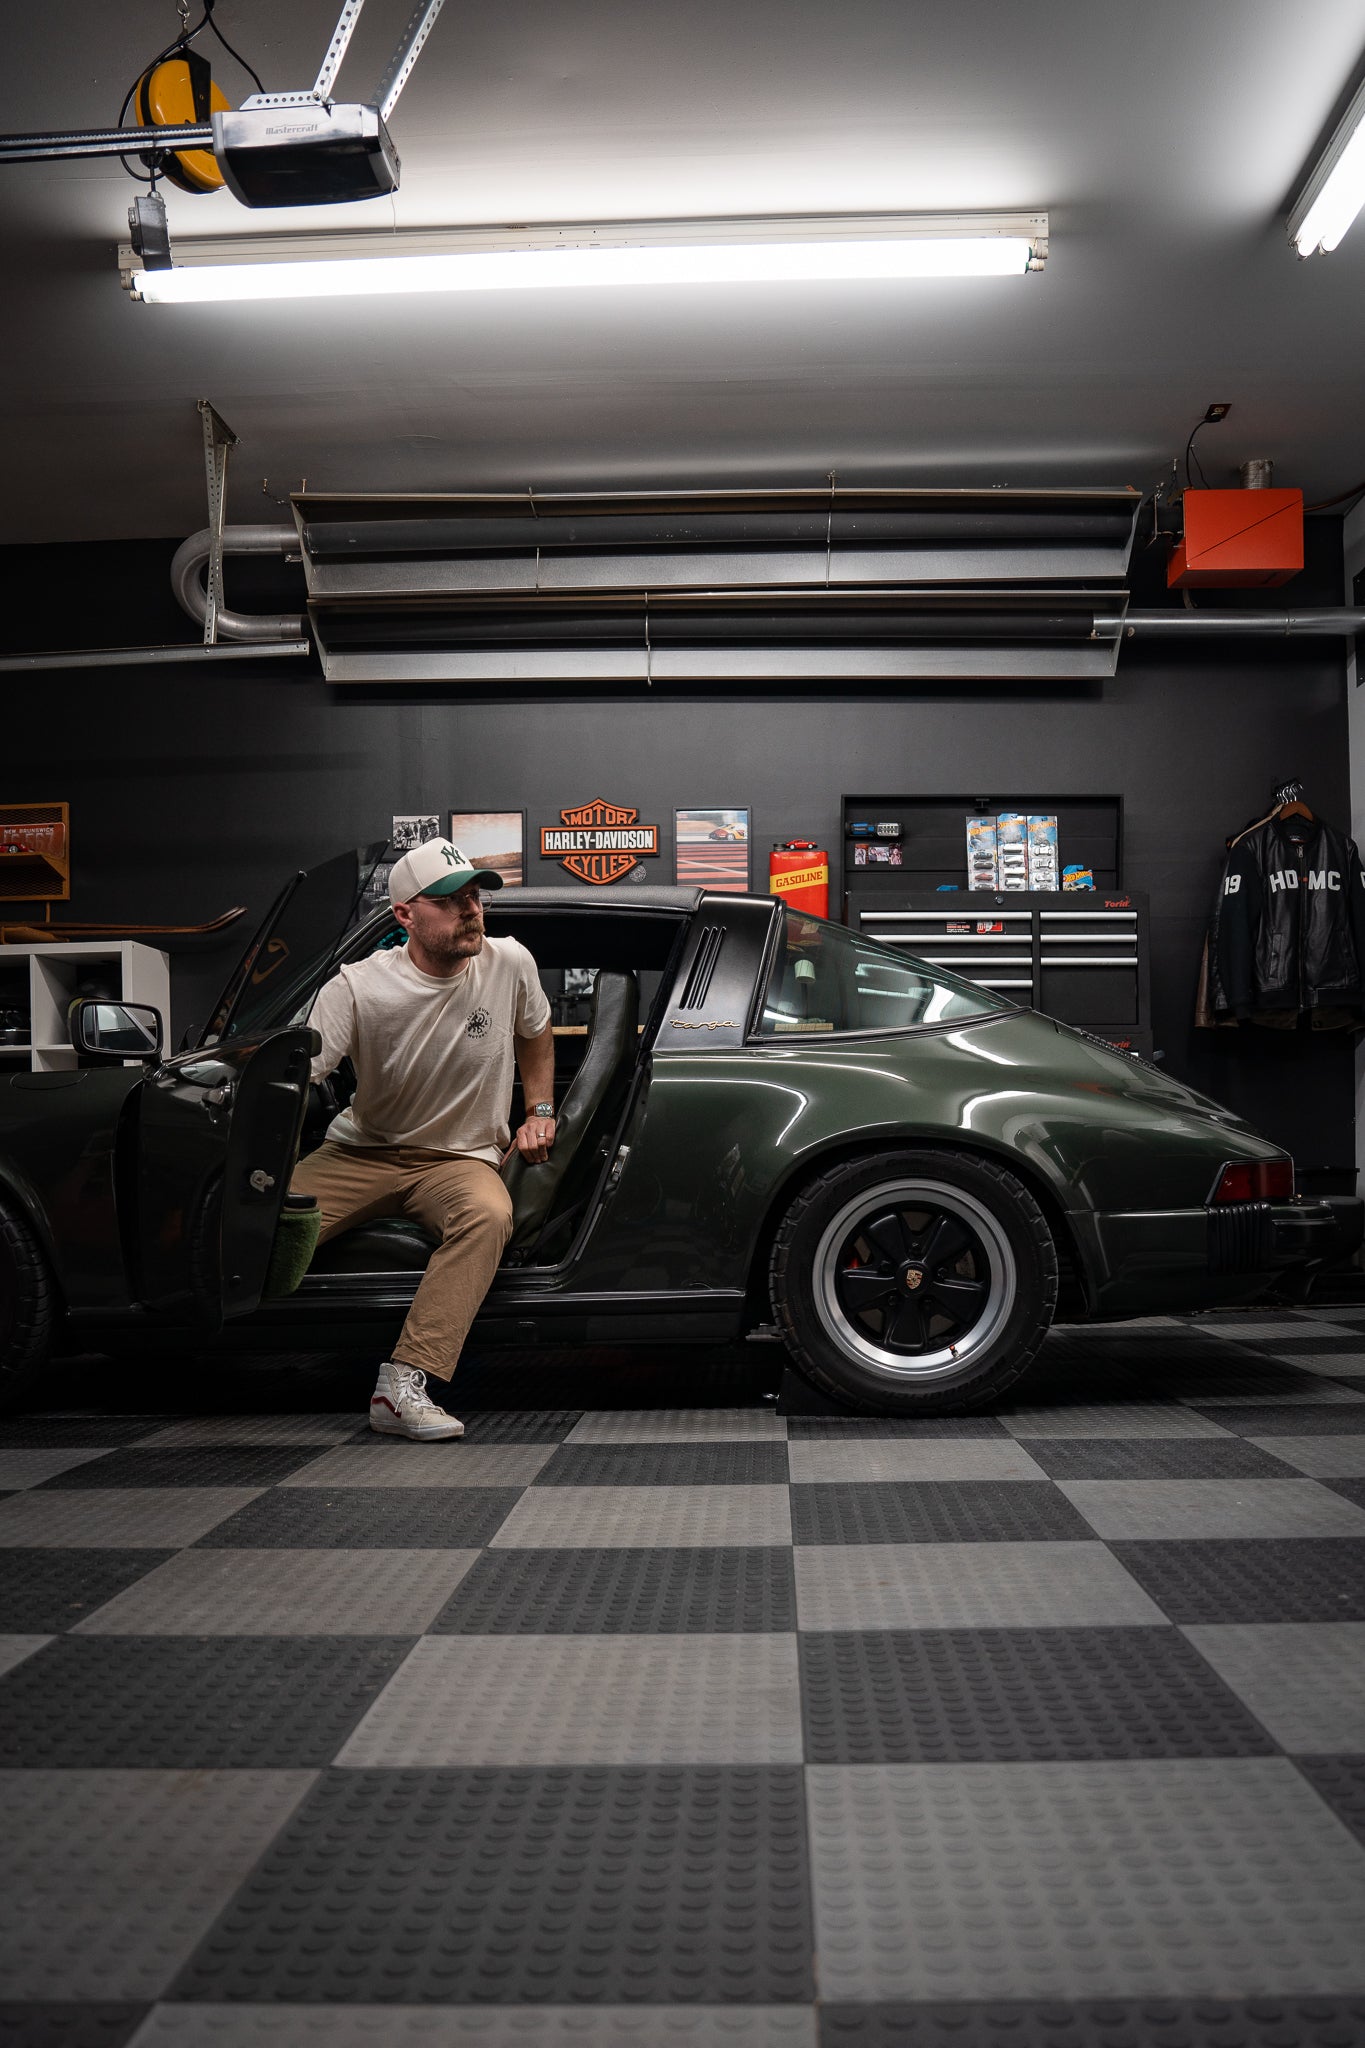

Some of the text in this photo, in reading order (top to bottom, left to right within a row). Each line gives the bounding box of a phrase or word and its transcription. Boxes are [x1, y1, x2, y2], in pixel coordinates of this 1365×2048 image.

[570, 804, 628, 825] MOTOR
[545, 830, 654, 850] HARLEY-DAVIDSON
[440, 845, 466, 867] NY
[570, 855, 629, 880] CYCLES
[775, 870, 823, 888] GASOLINE
[1224, 874, 1242, 896] 19
[1269, 869, 1299, 893] HD
[1307, 869, 1341, 891] MC
